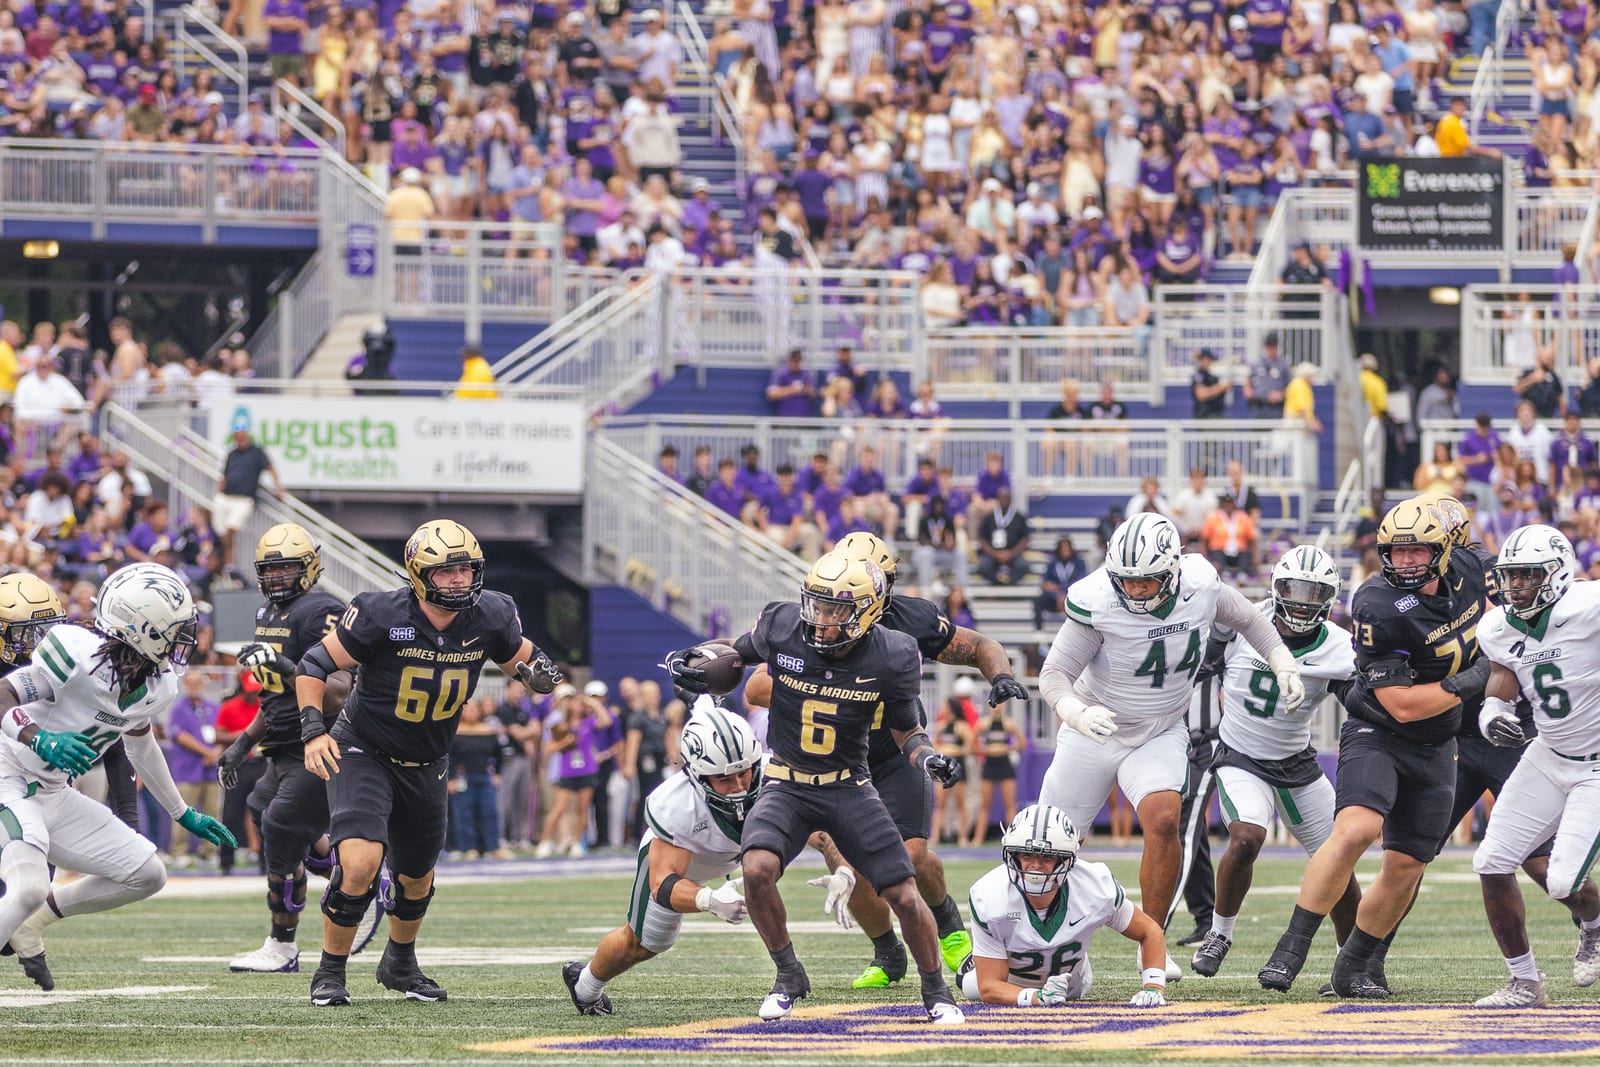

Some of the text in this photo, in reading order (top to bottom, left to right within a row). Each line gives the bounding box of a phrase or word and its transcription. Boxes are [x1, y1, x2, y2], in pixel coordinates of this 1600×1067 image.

[1404, 169, 1495, 192] Everence
[414, 416, 573, 441] Care that makes
[309, 453, 399, 480] Health
[389, 626, 415, 641] SBC
[1148, 621, 1189, 639] WAGNER
[1425, 600, 1479, 645] JAMES MADISON
[396, 647, 484, 663] JAMES MADISON
[777, 653, 804, 673] SBC
[1134, 627, 1201, 689] 44
[1521, 647, 1562, 665] WAGNER
[394, 665, 470, 724] 60
[778, 674, 881, 702] JAMES MADISON
[1244, 670, 1281, 719] 9
[1532, 662, 1571, 719] 6
[800, 699, 839, 756] 6
[1008, 941, 1083, 981] 26
